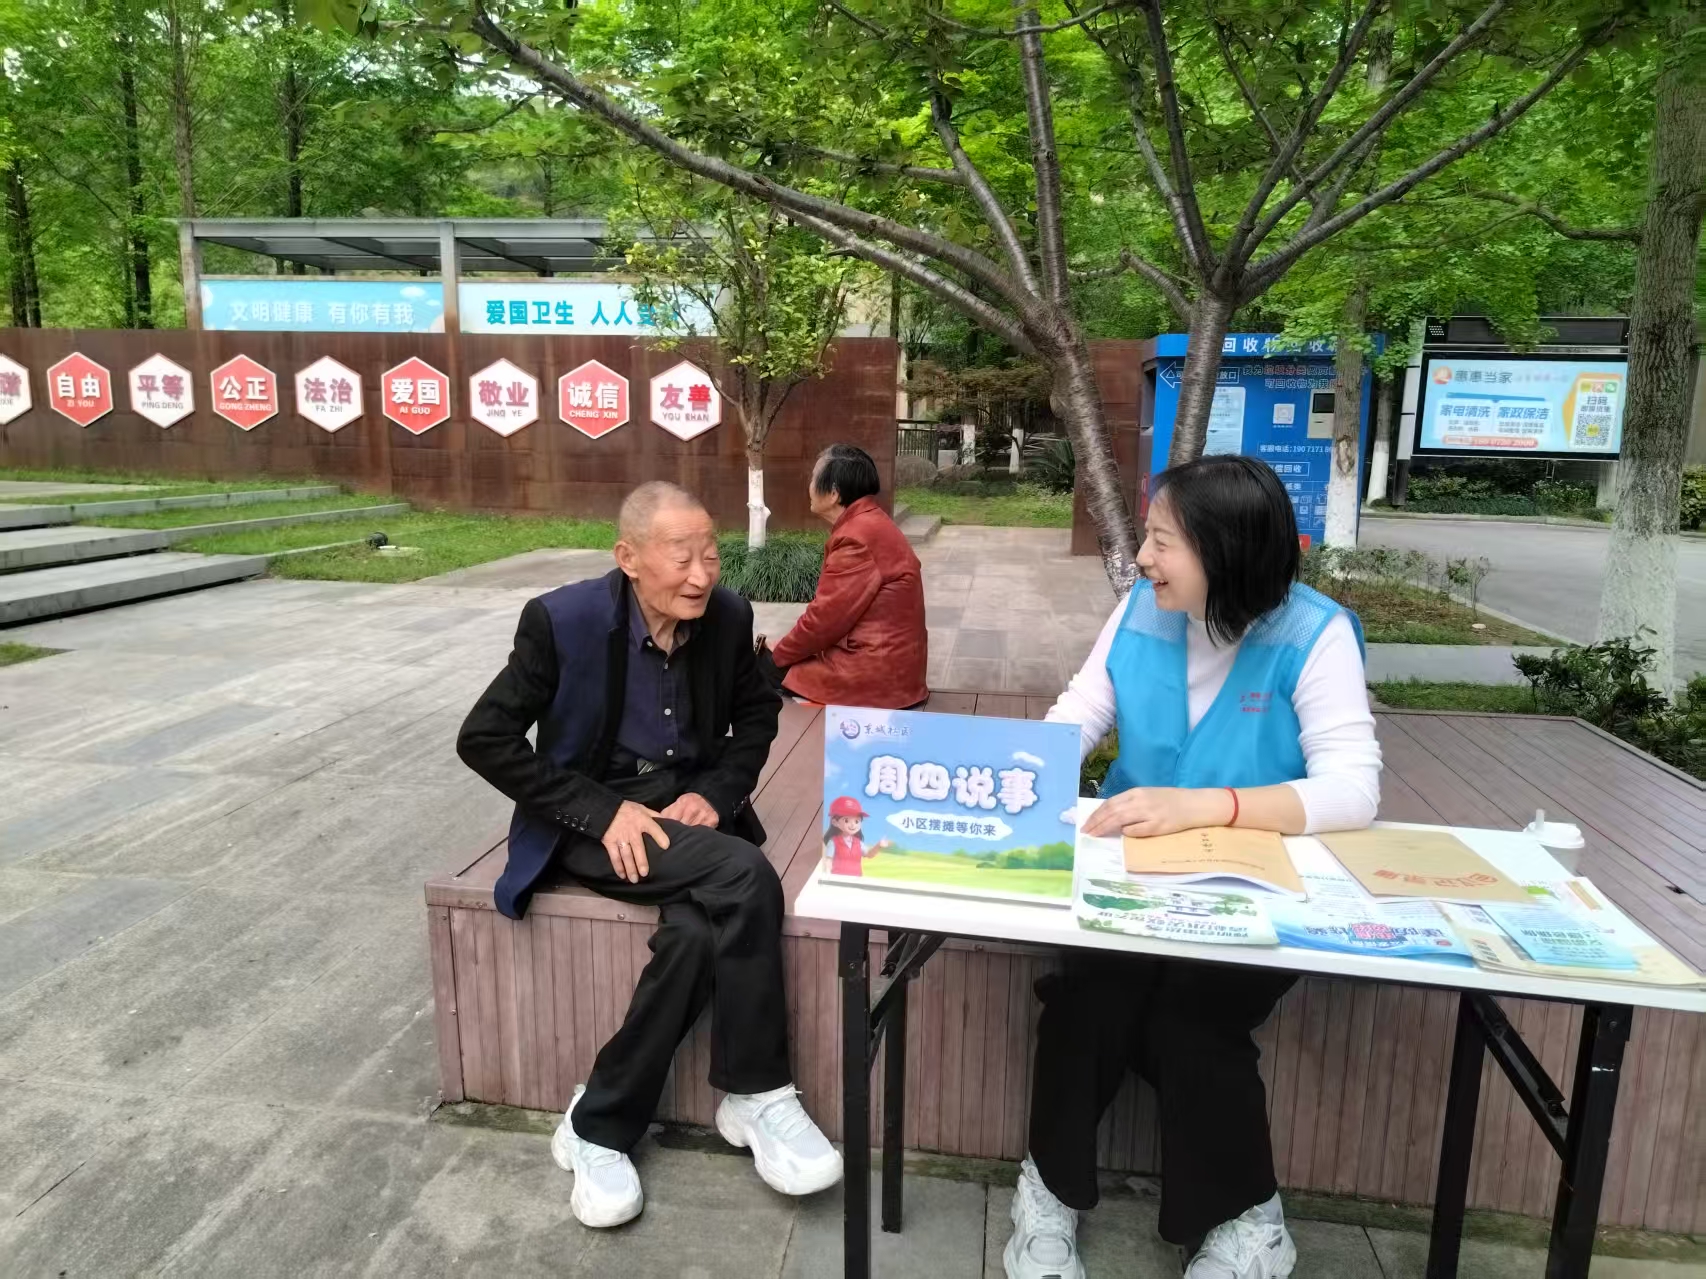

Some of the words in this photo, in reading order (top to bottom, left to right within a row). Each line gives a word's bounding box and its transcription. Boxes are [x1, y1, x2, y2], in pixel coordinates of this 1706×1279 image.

[231, 301, 313, 322] 文明健康
[328, 302, 415, 325] 有你有我
[486, 300, 575, 326] 爱国卫生
[57, 373, 101, 398] 自由
[137, 374, 185, 398] 平等
[219, 376, 269, 401] 公正
[304, 378, 353, 404] 法治
[391, 378, 440, 405] 爱国
[478, 380, 529, 407] 敬业
[567, 382, 619, 409] 诚信
[660, 383, 711, 411] 友善
[67, 399, 75, 407] ZI
[77, 399, 95, 407] YOU
[141, 401, 160, 409] PING
[162, 402, 184, 410] DENG
[219, 403, 242, 411] GONG
[244, 403, 272, 412] ZHENG
[316, 405, 327, 413] FA
[329, 405, 343, 413] ZHI
[400, 406, 408, 415] AI
[412, 406, 430, 415] GUO
[512, 410, 523, 418] YE
[569, 410, 599, 420] CHENG
[603, 411, 618, 420] XIN
[662, 411, 681, 421] YOU
[864, 754, 1038, 814] 周四说事
[902, 816, 997, 836] 小区摆摊等你来
